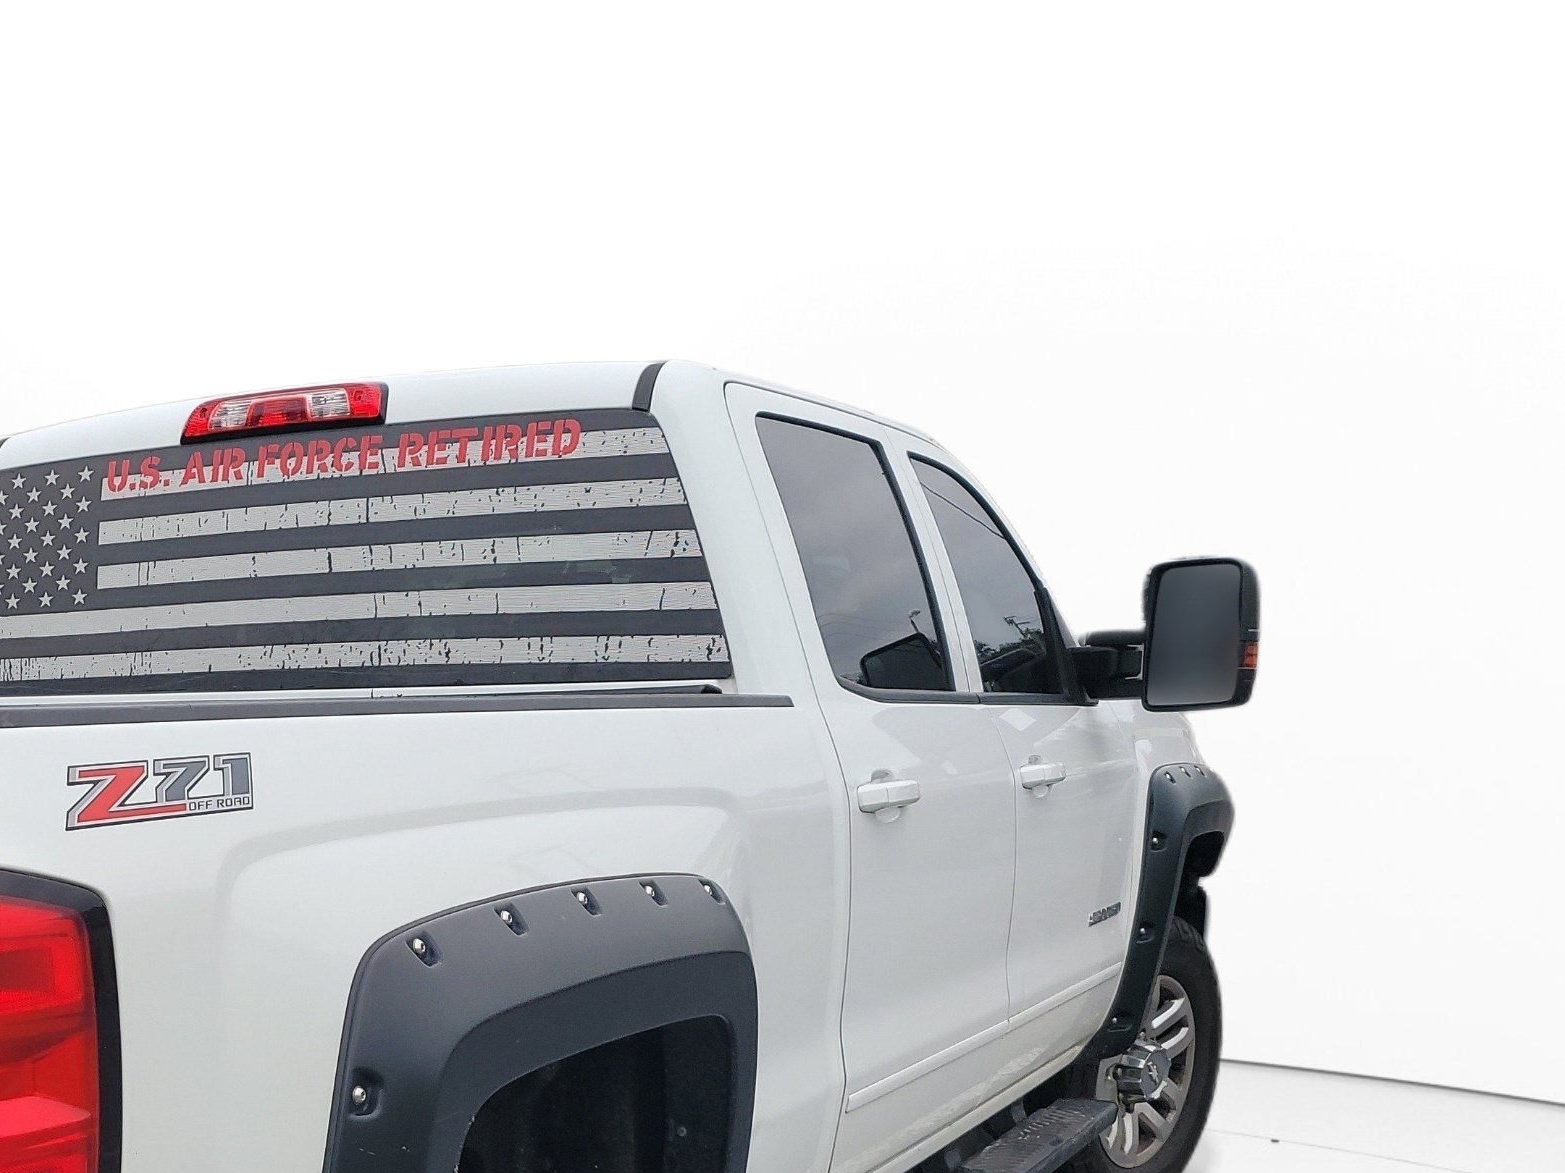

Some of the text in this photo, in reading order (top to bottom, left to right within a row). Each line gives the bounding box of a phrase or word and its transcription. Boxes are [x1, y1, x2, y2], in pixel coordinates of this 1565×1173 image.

[106, 418, 582, 493] U.S. AIR FORCE RETIRED
[65, 752, 253, 831] Z71
[188, 796, 250, 811] OFF ROAD
